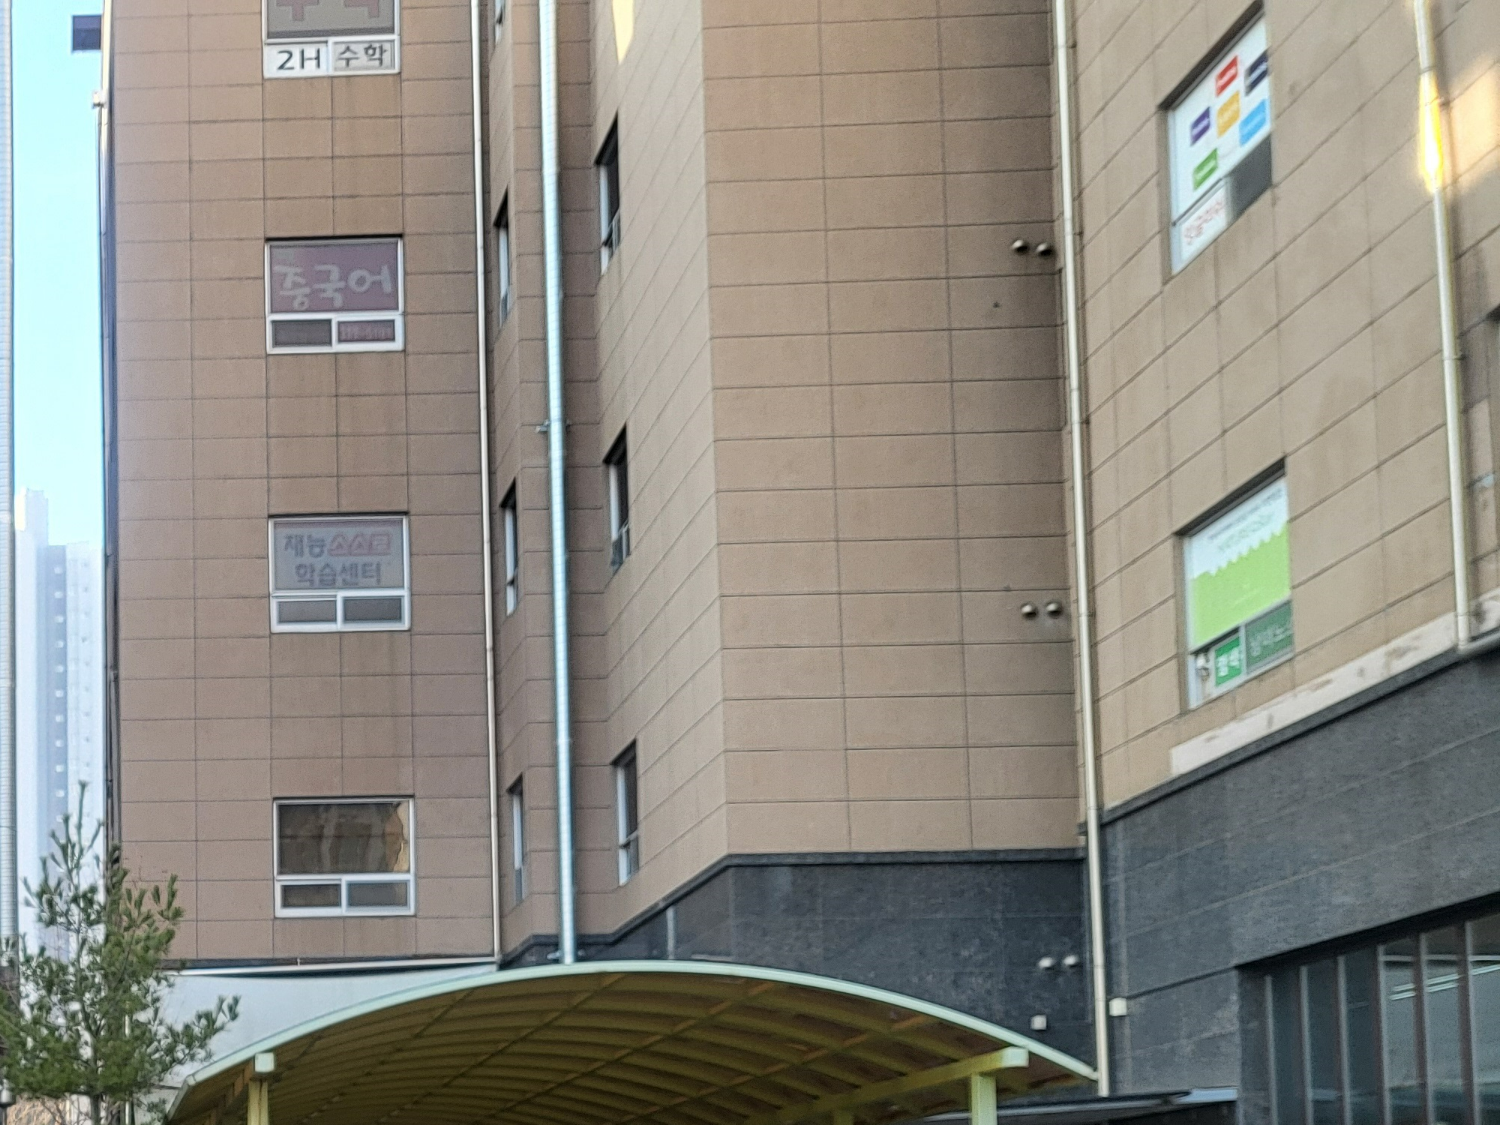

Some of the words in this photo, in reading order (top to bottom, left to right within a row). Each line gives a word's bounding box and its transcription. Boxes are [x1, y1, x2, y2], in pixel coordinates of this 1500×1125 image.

[276, 48, 321, 71] 2H
[337, 44, 388, 68] 수학
[273, 264, 393, 311] 중국어
[294, 561, 382, 588] 학습센터
